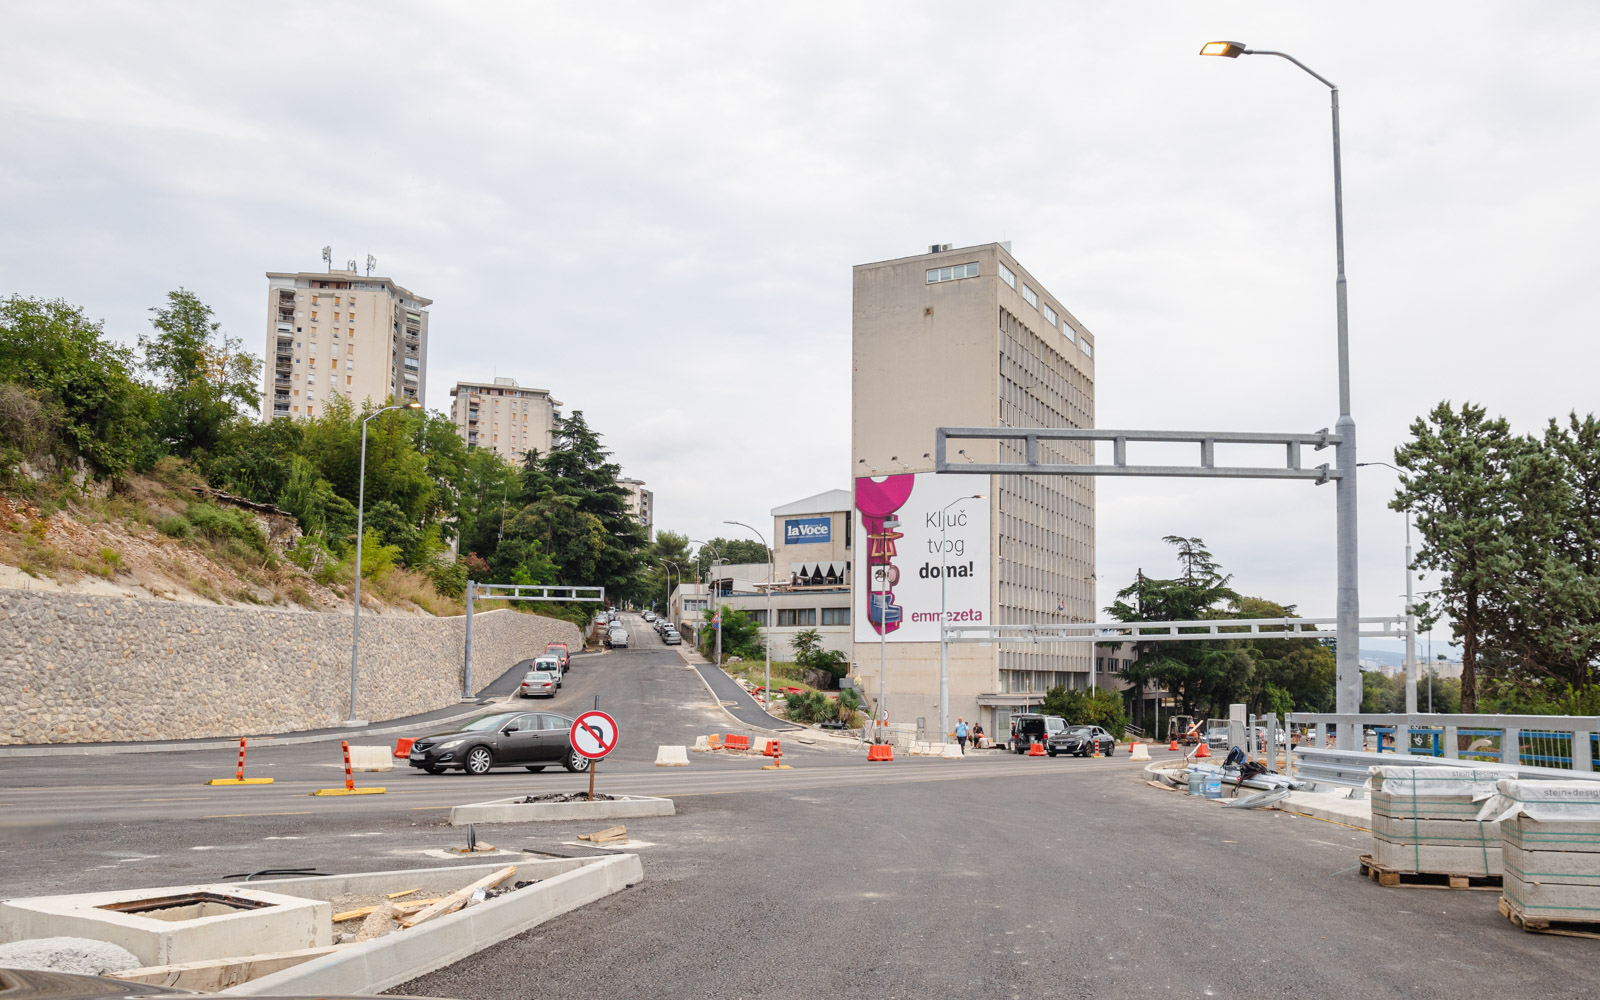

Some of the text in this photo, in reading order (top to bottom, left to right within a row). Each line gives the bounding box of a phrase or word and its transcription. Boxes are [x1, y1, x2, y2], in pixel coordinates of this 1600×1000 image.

[926, 509, 967, 532] Ključ
[927, 538, 964, 556] tvog
[919, 561, 973, 579] doma!
[1543, 789, 1600, 799] stein+desig
